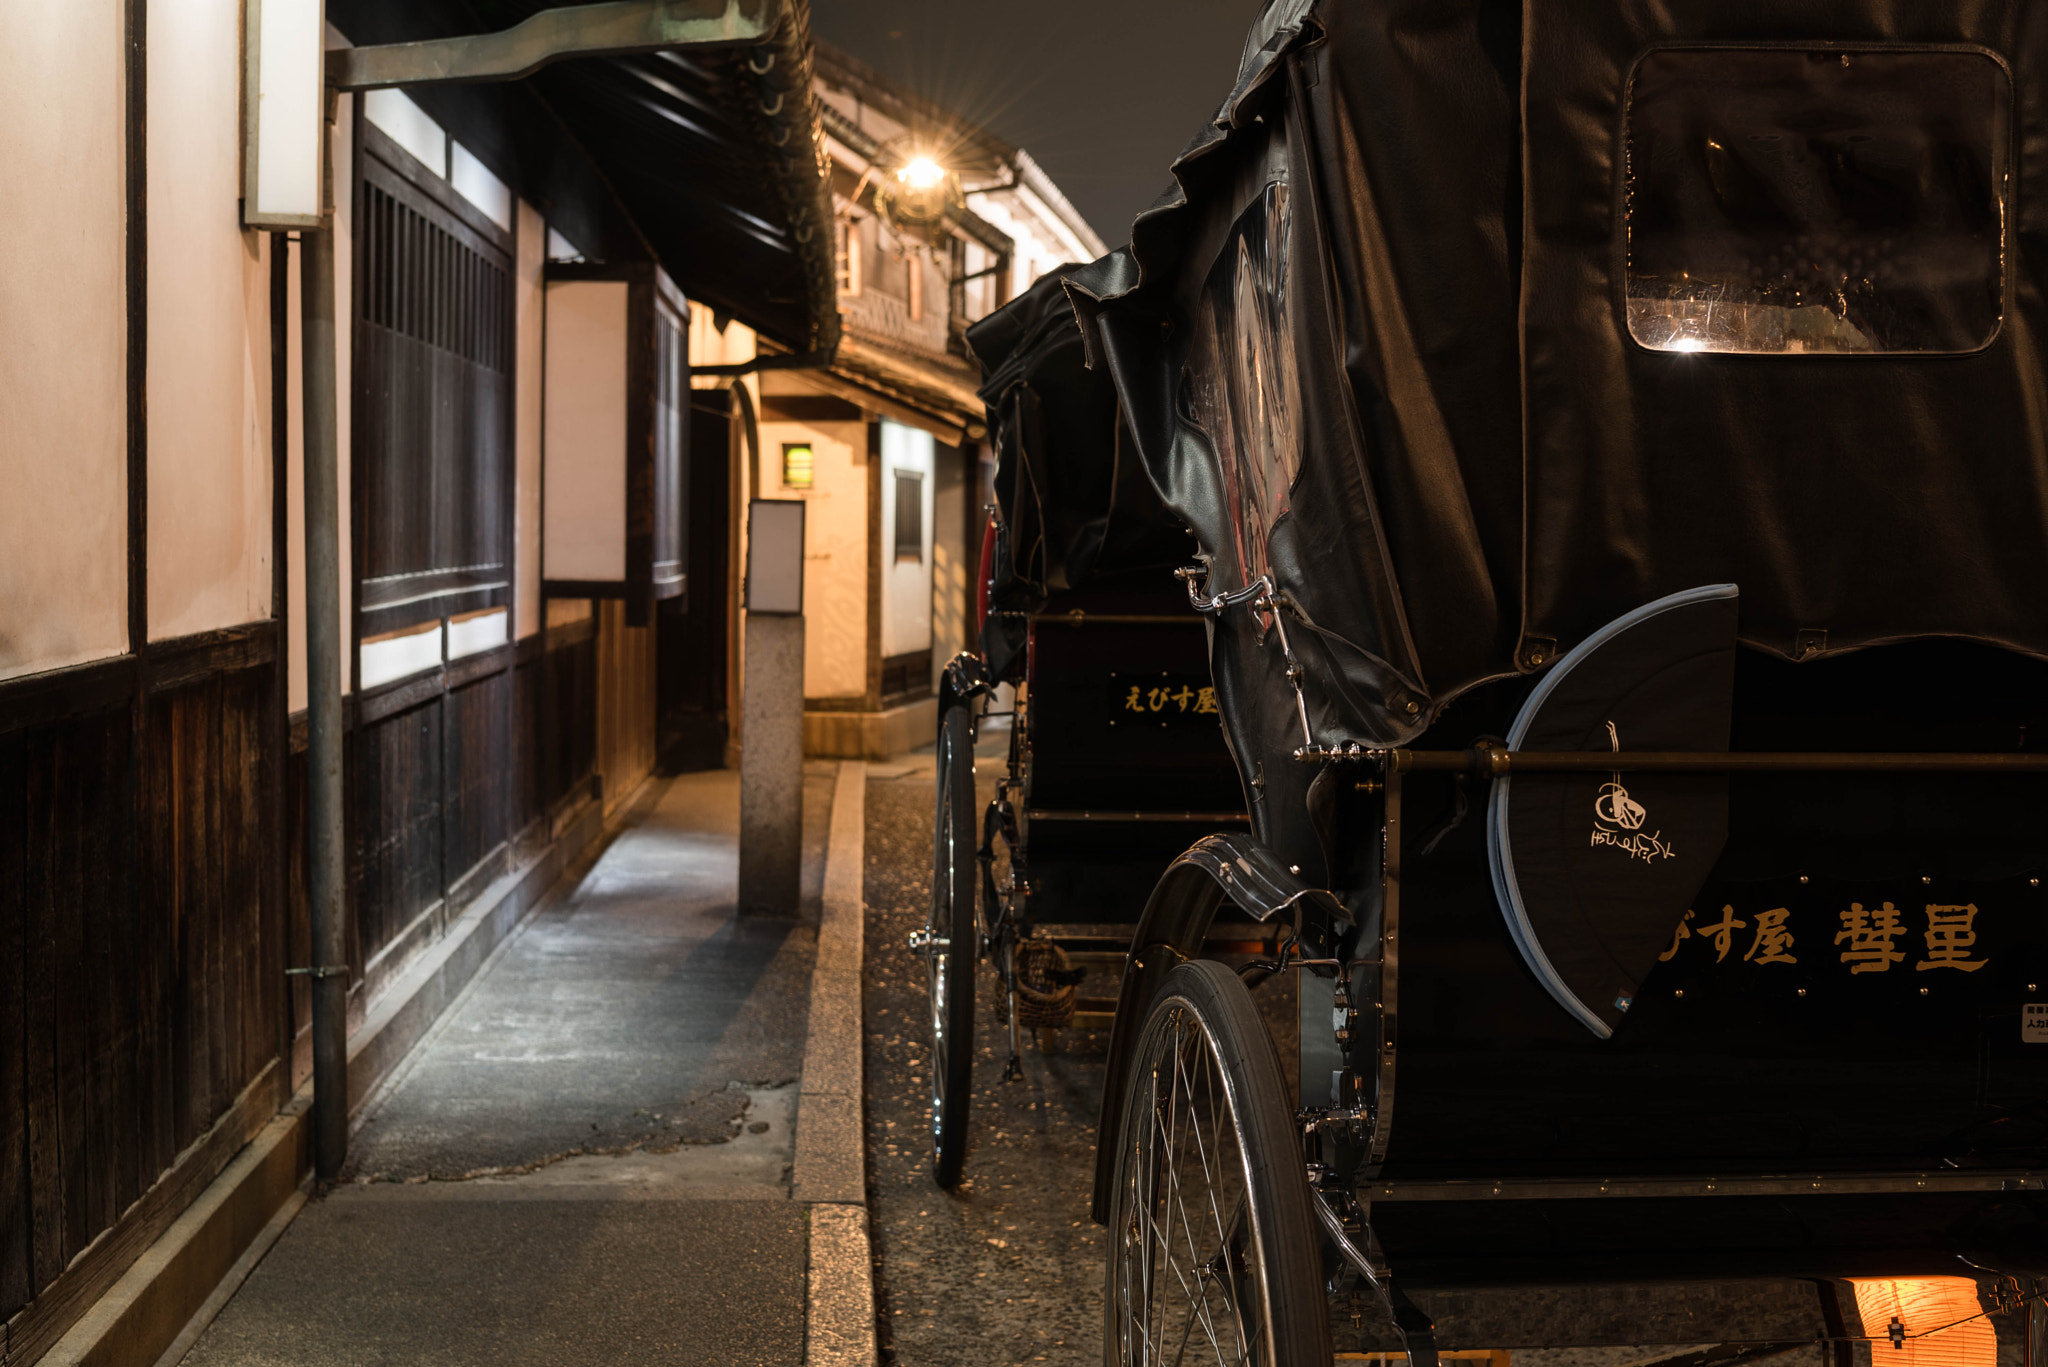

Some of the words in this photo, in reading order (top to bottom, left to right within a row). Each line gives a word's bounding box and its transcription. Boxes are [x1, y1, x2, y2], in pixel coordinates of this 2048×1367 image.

[1124, 685, 1219, 714] えびす屋
[2027, 1019, 2048, 1028] 人力
